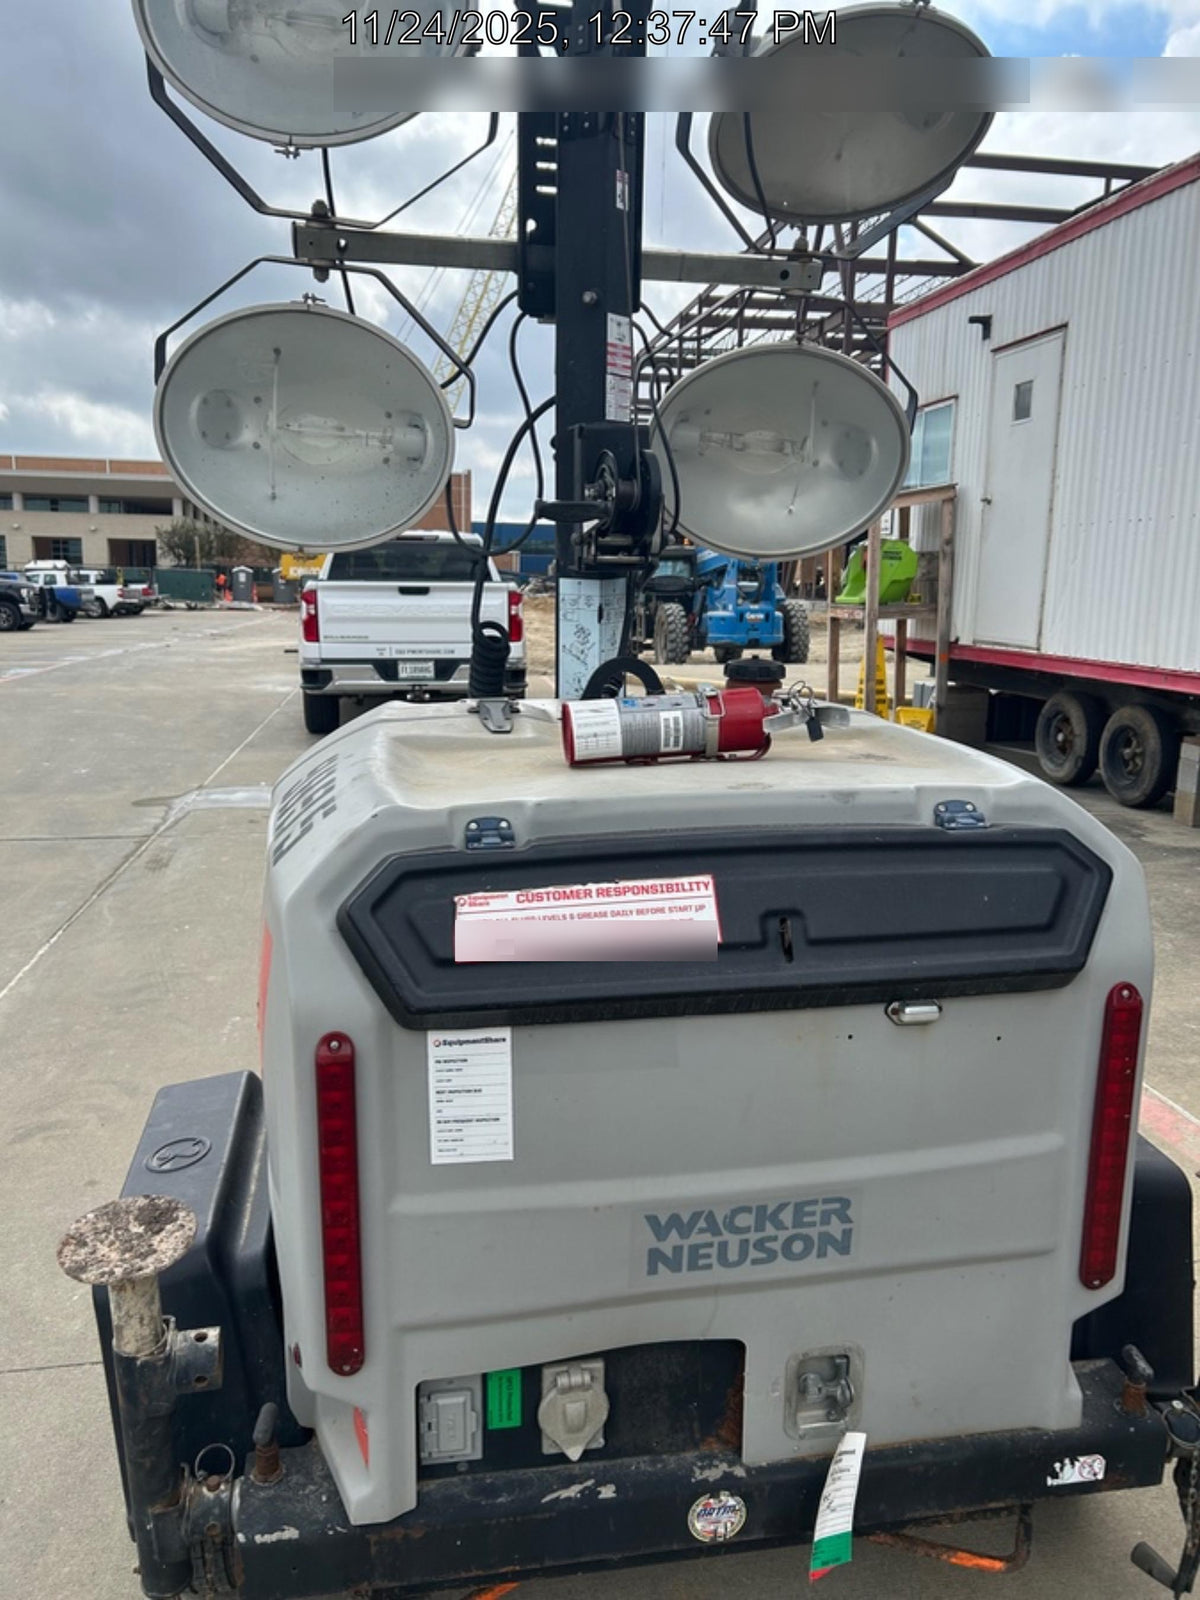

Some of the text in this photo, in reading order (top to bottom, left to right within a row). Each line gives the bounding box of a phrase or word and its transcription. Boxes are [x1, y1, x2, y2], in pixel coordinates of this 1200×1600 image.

[515, 881, 711, 904] CUSTOMER RESPONSIBILITY
[576, 909, 609, 920] GREASE
[610, 908, 634, 917] DAILY
[636, 906, 666, 916] BEFORE
[668, 904, 693, 914] START
[694, 903, 707, 913] UP
[644, 1196, 854, 1242] WACKER
[646, 1228, 853, 1276] NEUSON
